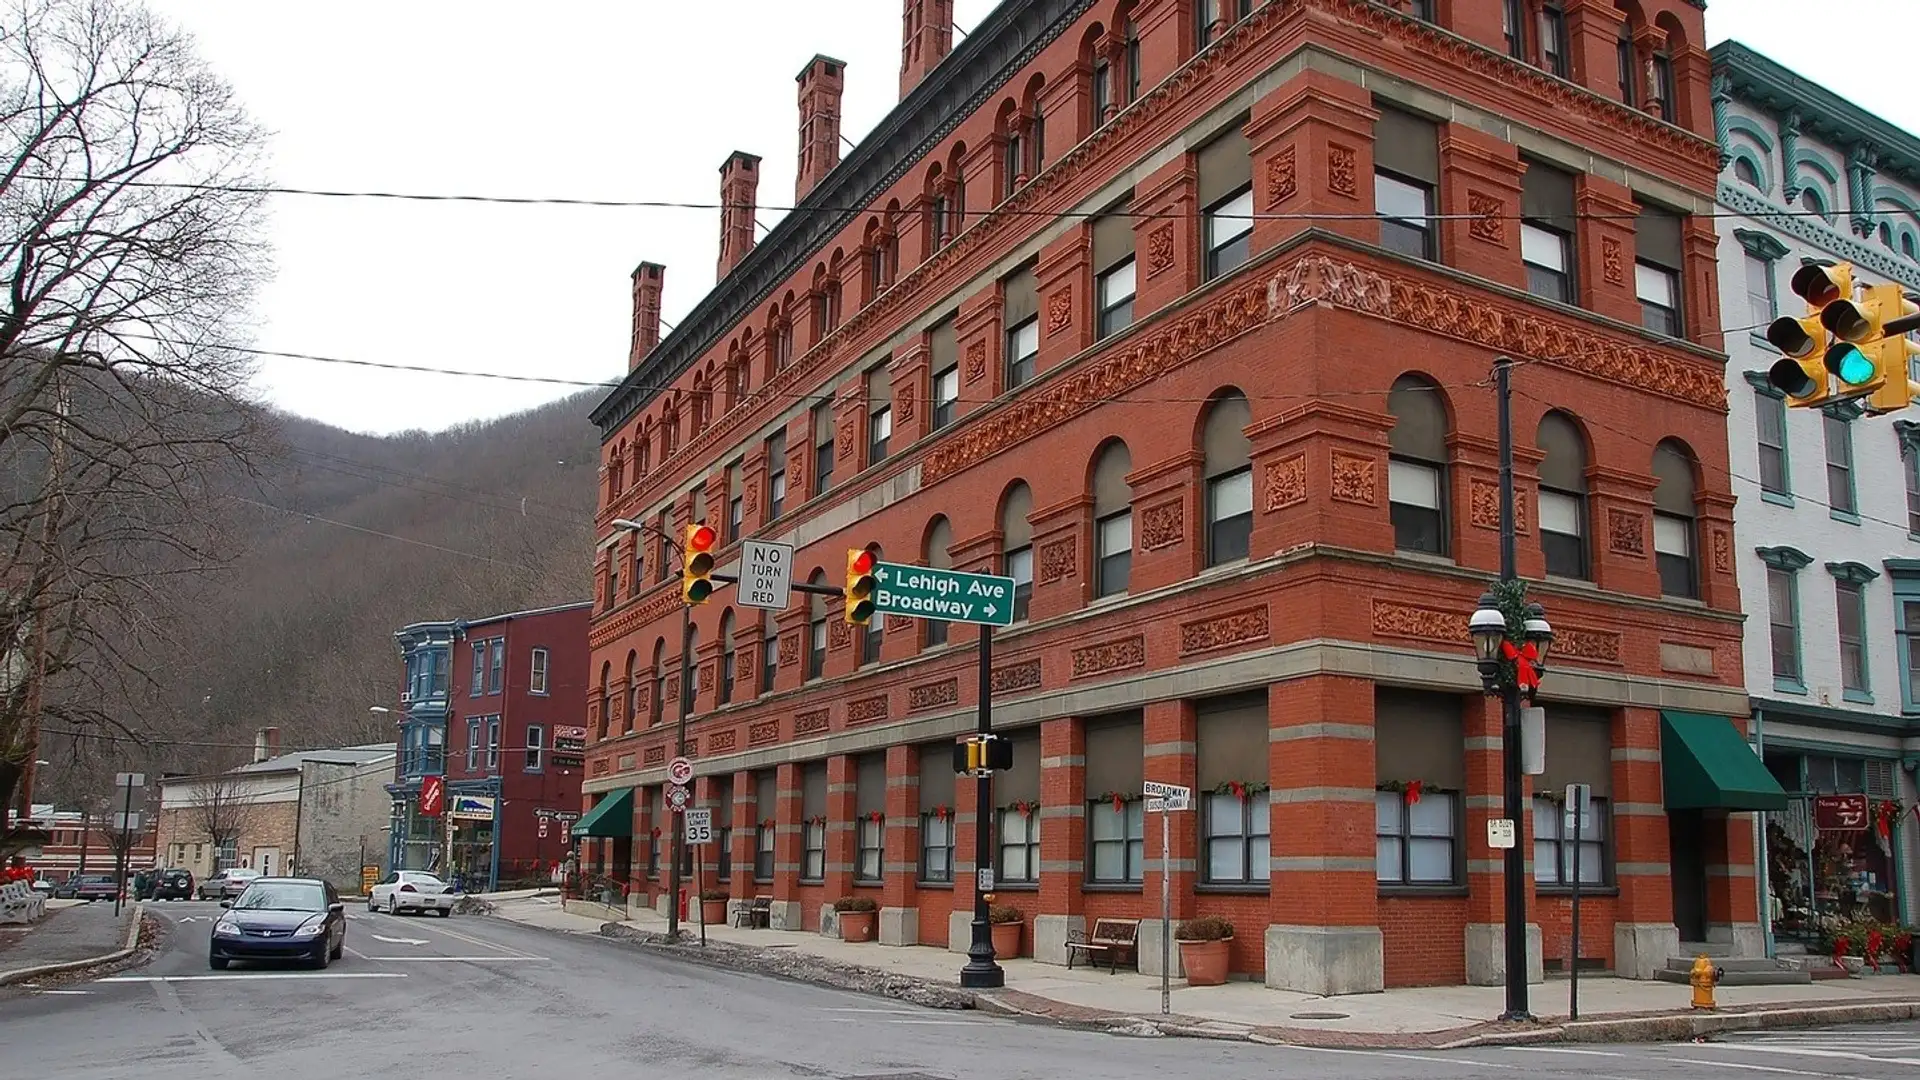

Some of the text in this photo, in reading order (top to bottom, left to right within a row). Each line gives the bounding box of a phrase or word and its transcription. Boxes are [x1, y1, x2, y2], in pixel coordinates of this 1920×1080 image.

[754, 547, 780, 563] NO
[751, 563, 781, 577] TURN
[756, 578, 773, 589] ON
[896, 570, 1005, 598] Lehigh Ave
[752, 591, 775, 603] RED
[876, 590, 973, 619] Broadway
[1145, 783, 1187, 797] BROADWAY
[688, 827, 709, 840] 35
